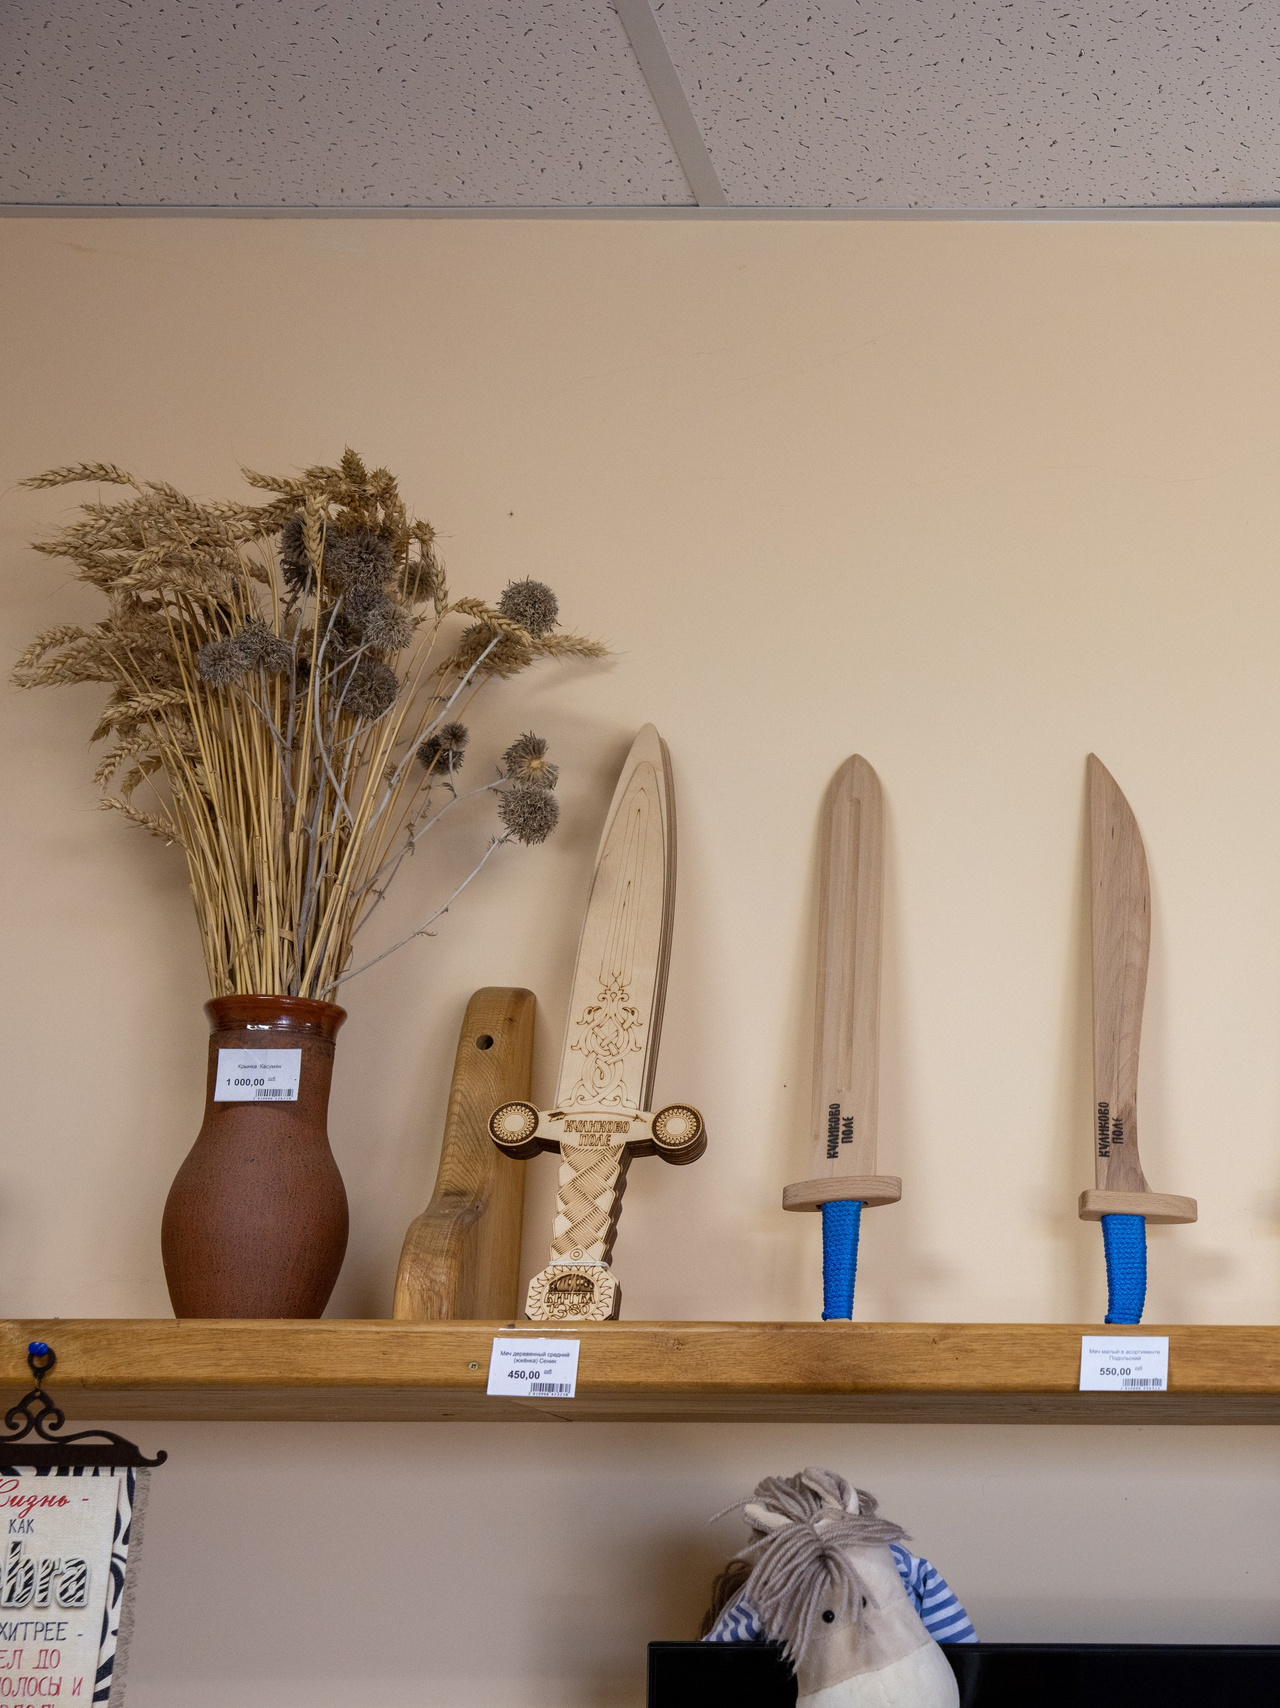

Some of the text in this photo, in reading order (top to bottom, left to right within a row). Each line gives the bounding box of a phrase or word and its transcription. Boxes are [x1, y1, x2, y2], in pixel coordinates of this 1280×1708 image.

[234, 1078, 265, 1087] 000,00
[563, 1120, 631, 1133] КУЛИКОВО
[827, 1103, 840, 1159] КУЛИКОВО
[841, 1116, 854, 1144] ПОЛЕ
[1098, 1101, 1110, 1158] КУЛИКОВО
[1112, 1117, 1124, 1144] ПОЛЕ
[579, 1134, 611, 1147] ПОЛЕ
[547, 1303, 591, 1319] 1380
[507, 1370, 540, 1380] 450,00
[1099, 1367, 1132, 1377] 550,00
[8, 1519, 34, 1534] КАК
[0, 1539, 89, 1608] bra
[32, 1649, 60, 1669] ДО
[0, 1676, 83, 1697] ОЛОСЫ И
